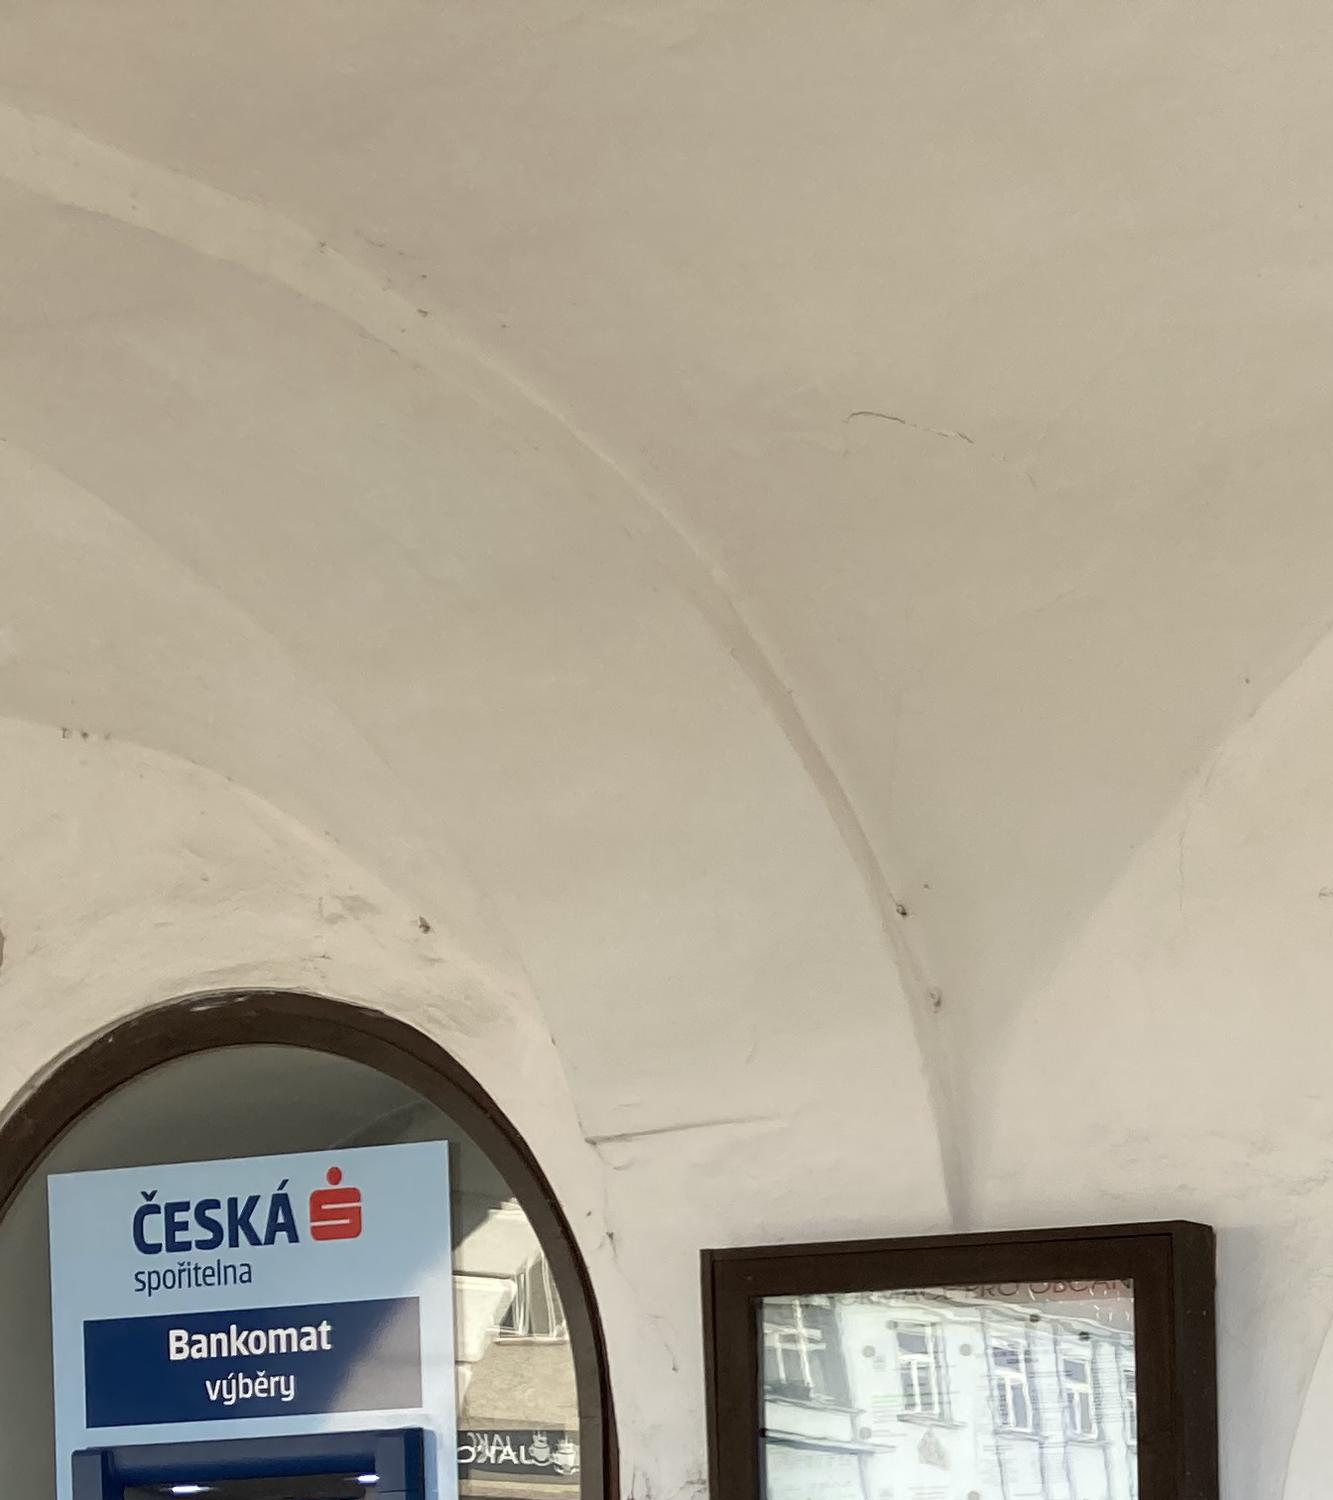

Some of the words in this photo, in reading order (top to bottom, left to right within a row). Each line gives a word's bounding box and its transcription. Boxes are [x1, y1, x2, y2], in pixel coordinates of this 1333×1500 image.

[133, 1179, 300, 1255] ČESKÁ
[134, 1259, 253, 1297] spořitelna
[169, 1320, 333, 1361] Bankomat
[205, 1370, 295, 1405] výběry
